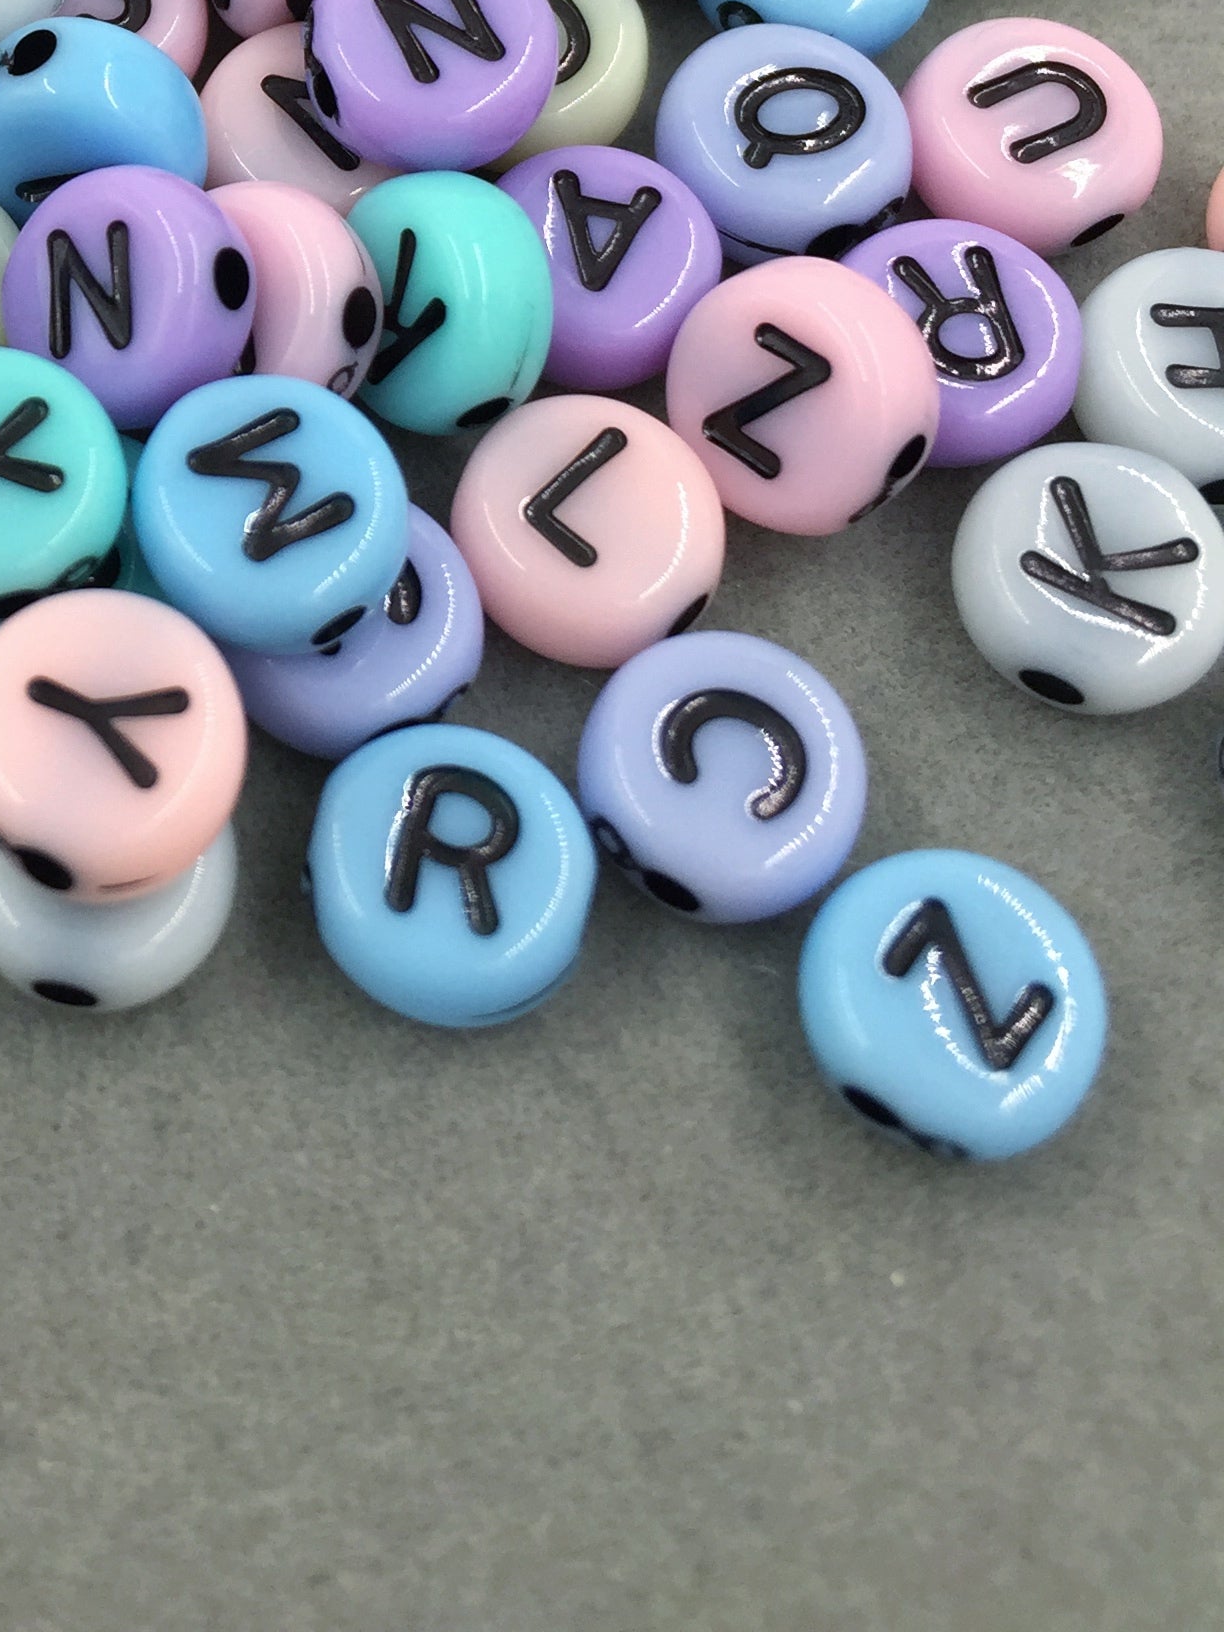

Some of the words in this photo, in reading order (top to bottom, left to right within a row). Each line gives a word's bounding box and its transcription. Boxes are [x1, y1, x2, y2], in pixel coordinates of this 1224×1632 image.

[734, 66, 867, 169] Q
[966, 60, 1108, 165] U
[47, 219, 131, 360] N
[553, 169, 663, 293] A
[891, 246, 1027, 382] R
[702, 322, 833, 480] Z
[523, 426, 628, 569] L
[1019, 475, 1199, 636] K
[27, 674, 190, 789] Y
[658, 687, 808, 821] C
[385, 764, 521, 937] R
